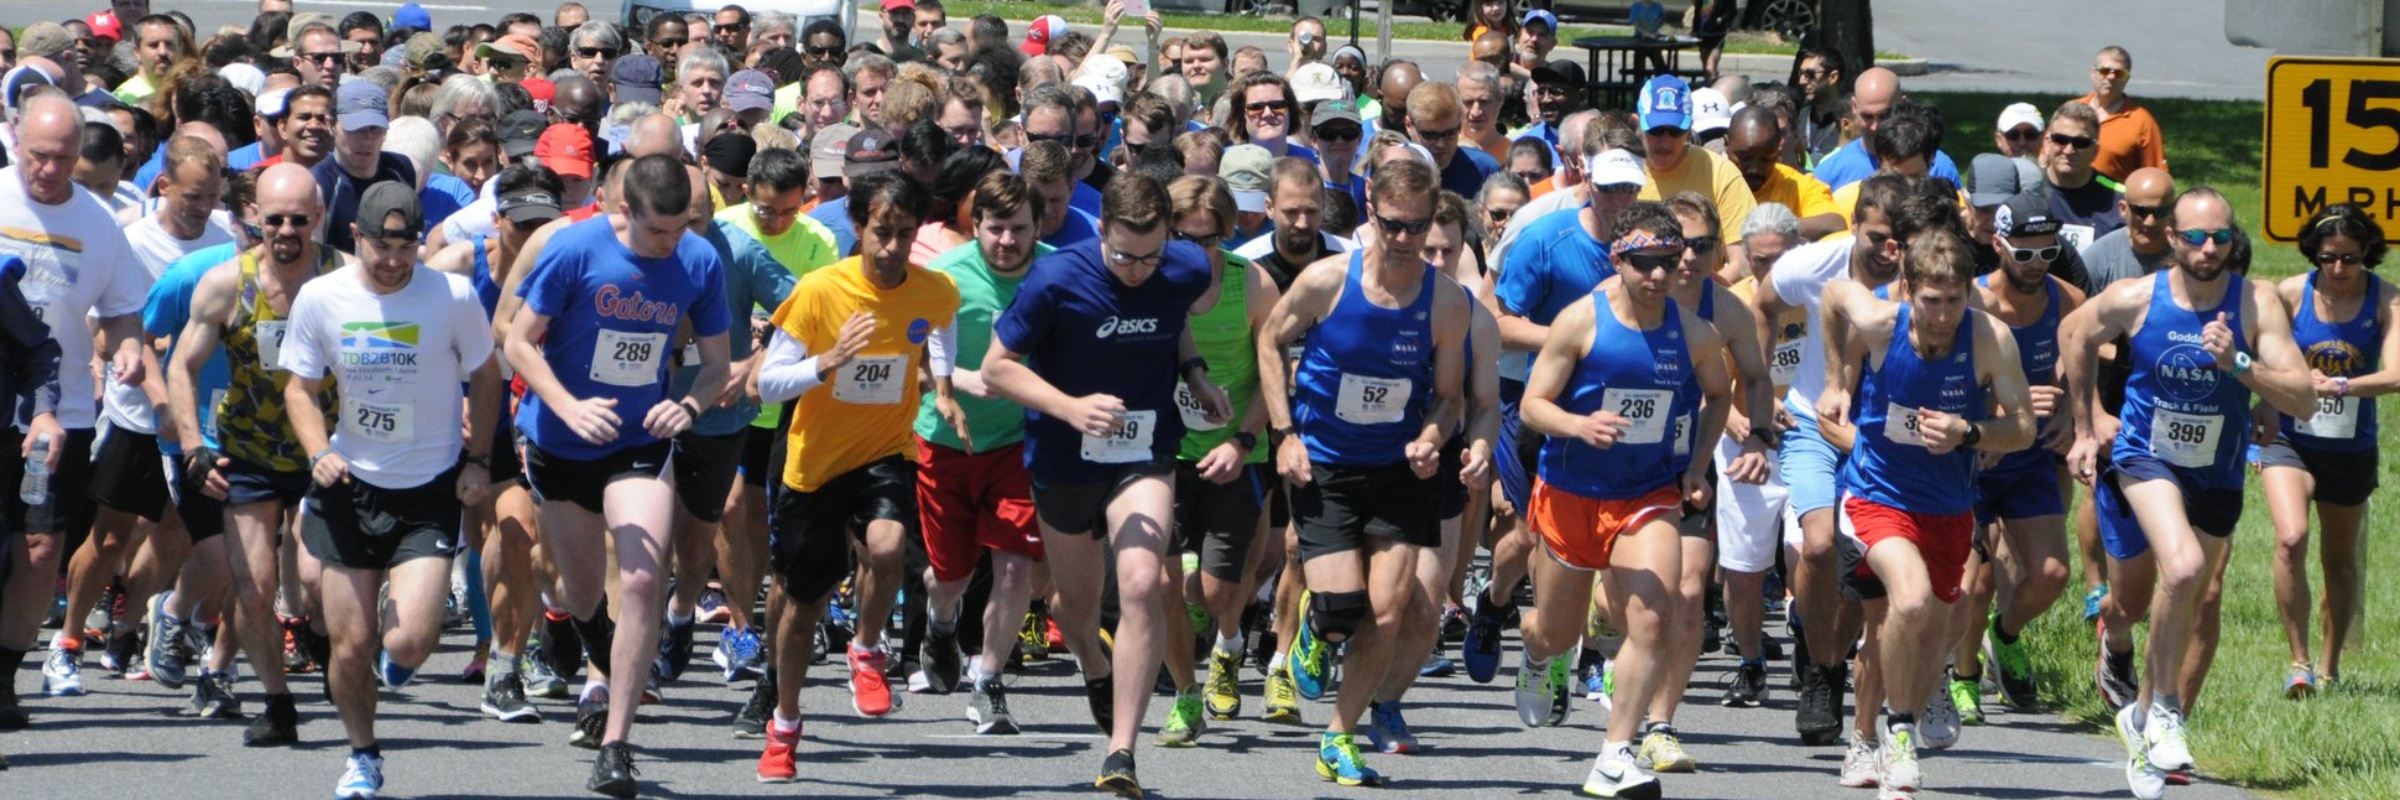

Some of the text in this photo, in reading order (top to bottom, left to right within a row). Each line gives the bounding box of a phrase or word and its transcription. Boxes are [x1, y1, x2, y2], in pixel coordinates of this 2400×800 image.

[2301, 78, 2400, 171] 15
[595, 284, 677, 326] Gators
[2168, 330, 2204, 344] Godda
[342, 352, 417, 366] TDB2B10K
[614, 342, 651, 362] 289
[854, 364, 891, 382] 204
[2161, 364, 2215, 382] NASA
[1363, 386, 1388, 404] 52
[1620, 399, 1655, 418] 236
[2153, 396, 2219, 413] Track & Field
[358, 408, 395, 432] 275
[2168, 421, 2206, 444] 399
